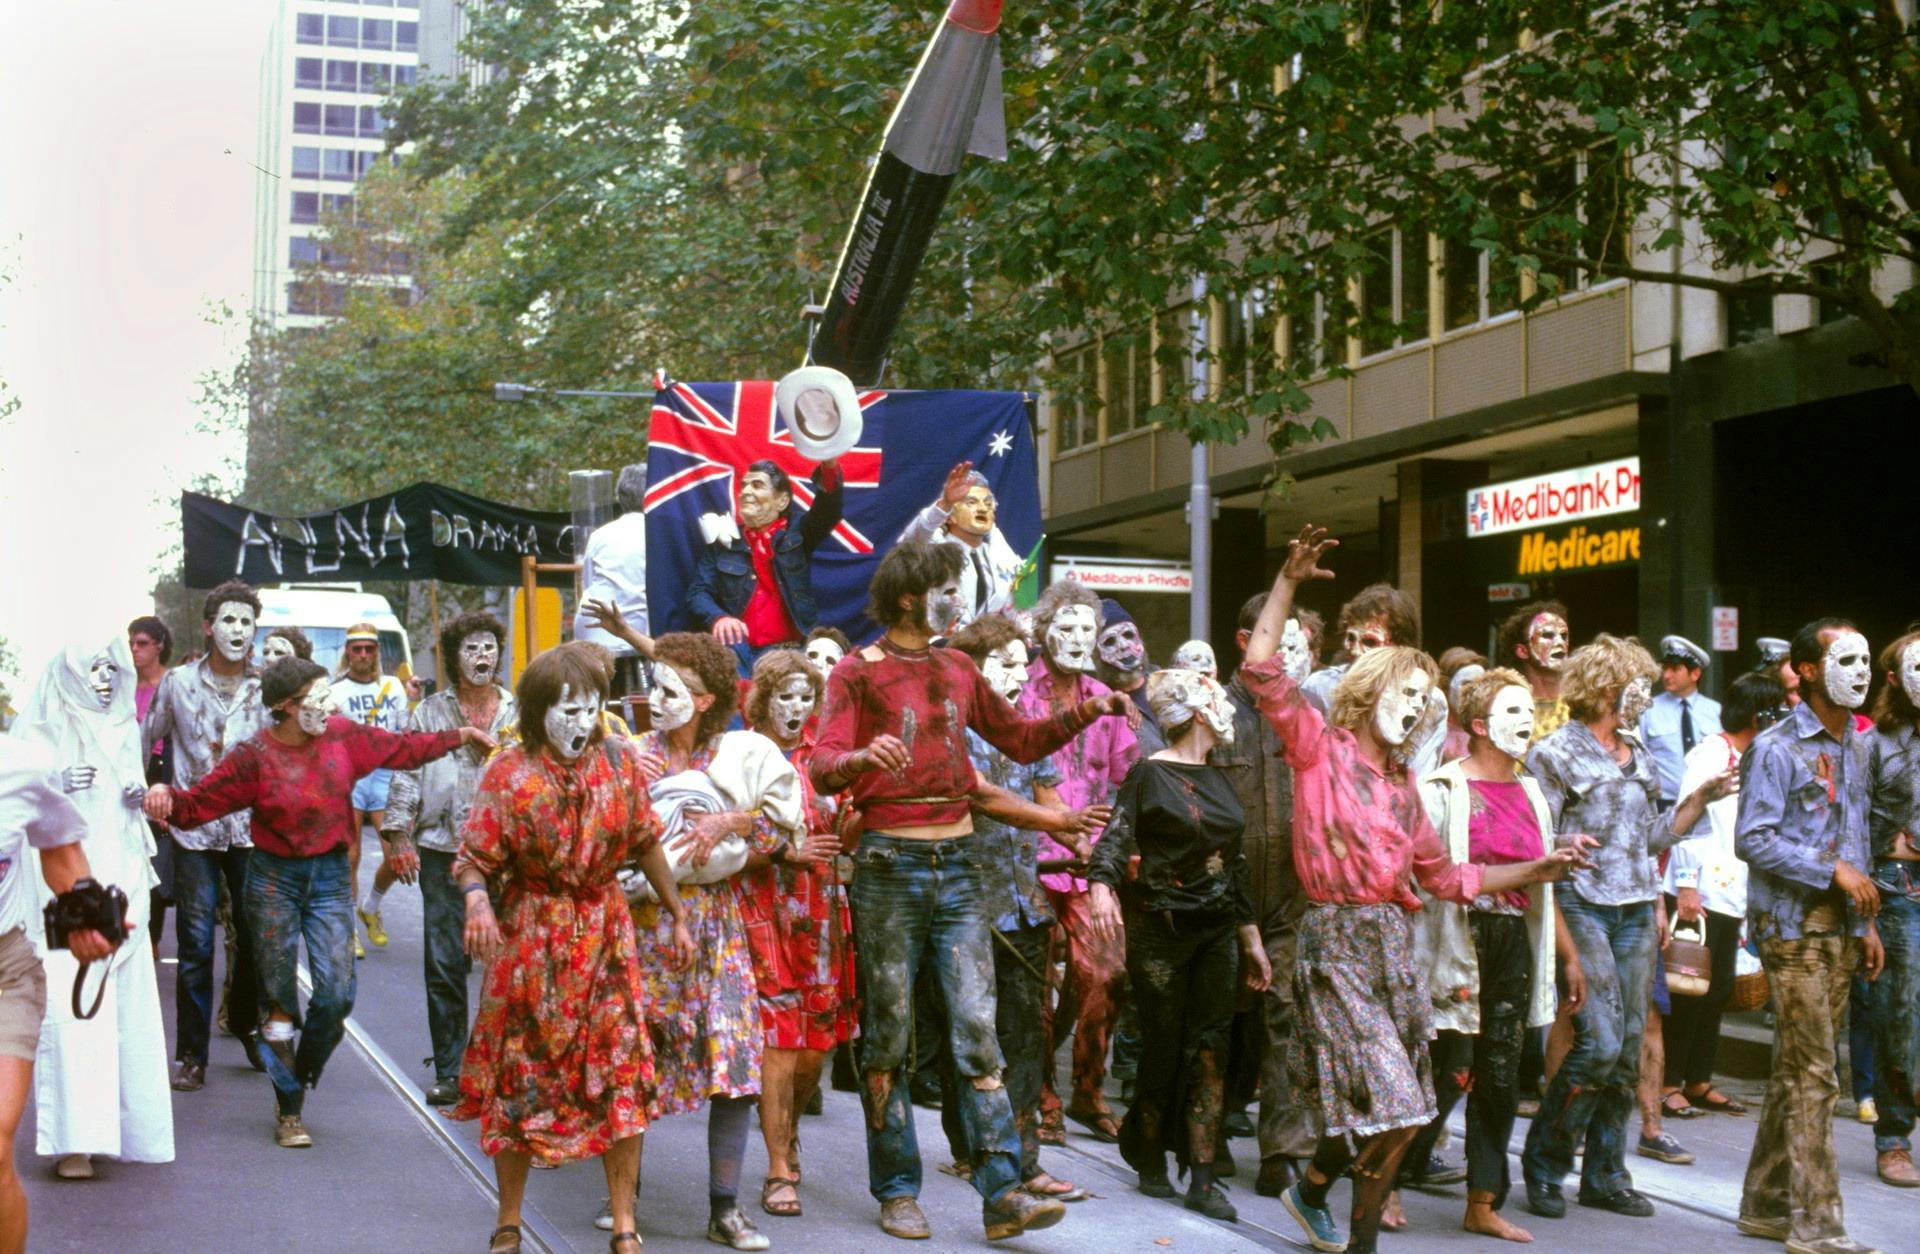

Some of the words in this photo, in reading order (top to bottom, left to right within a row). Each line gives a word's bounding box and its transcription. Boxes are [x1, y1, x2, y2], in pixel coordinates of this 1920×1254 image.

[841, 213, 885, 306] AUSTRALIA
[1492, 471, 1611, 527] Medibank
[431, 509, 542, 556] DRAMA
[1080, 571, 1144, 585] Medibank
[1148, 573, 1191, 587] Private
